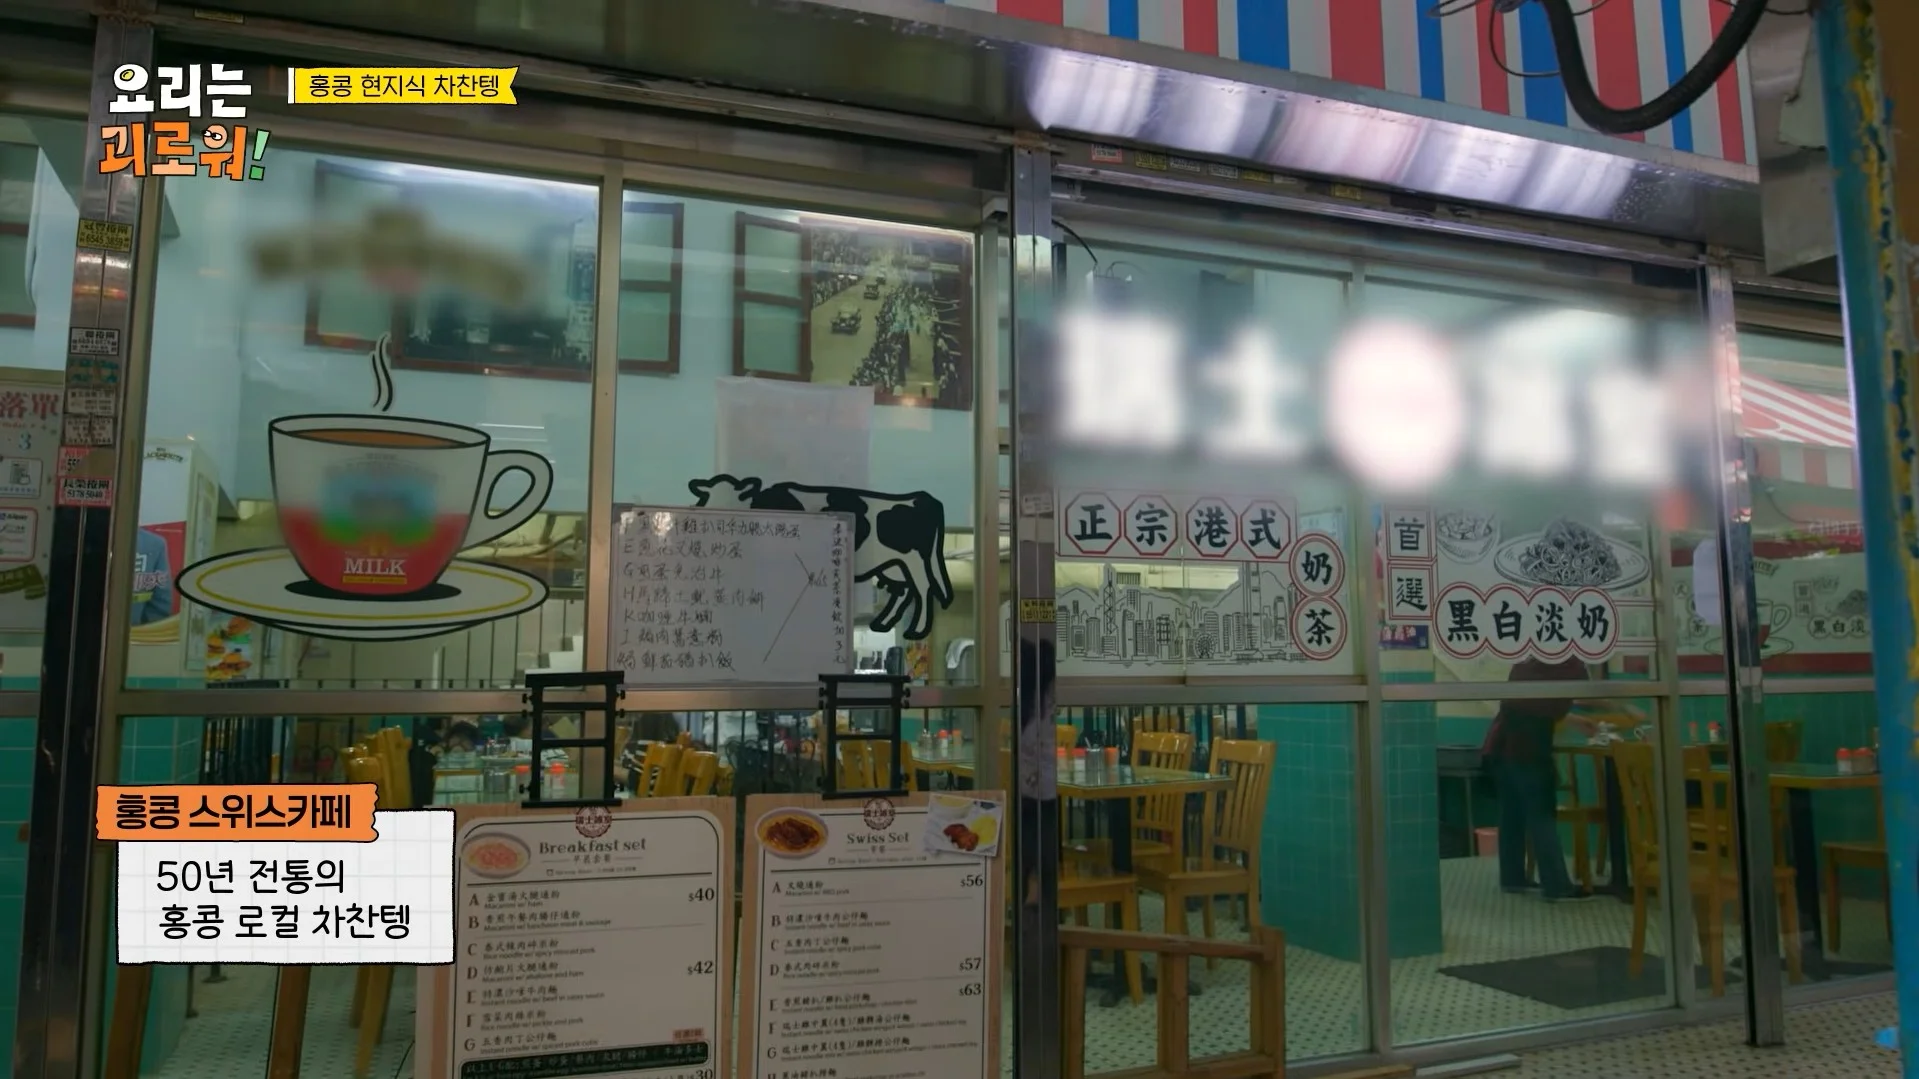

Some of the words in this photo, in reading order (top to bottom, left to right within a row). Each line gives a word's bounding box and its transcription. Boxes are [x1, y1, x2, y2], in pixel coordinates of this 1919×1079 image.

[1073, 503, 1283, 551] 正宗港式
[343, 557, 407, 576] MILK
[1393, 516, 1428, 612] 首選
[1302, 549, 1337, 647] 奶茶
[1446, 598, 1611, 643] 黑白淡奶
[846, 832, 886, 845] Swiss
[888, 831, 910, 843] Set
[539, 839, 619, 855] Breakfast
[623, 838, 647, 852] set
[771, 880, 782, 894] A
[960, 874, 984, 888] $56
[468, 892, 480, 907] A
[688, 887, 715, 903] $40
[468, 915, 480, 930] B
[771, 914, 782, 928] B
[467, 943, 478, 957] C
[770, 938, 780, 952] C
[687, 960, 714, 976] $42
[769, 964, 780, 977] D
[959, 957, 982, 971] $57
[466, 966, 478, 980] D
[959, 983, 982, 997] $63
[464, 1038, 476, 1052] G
[767, 1046, 777, 1059] G
